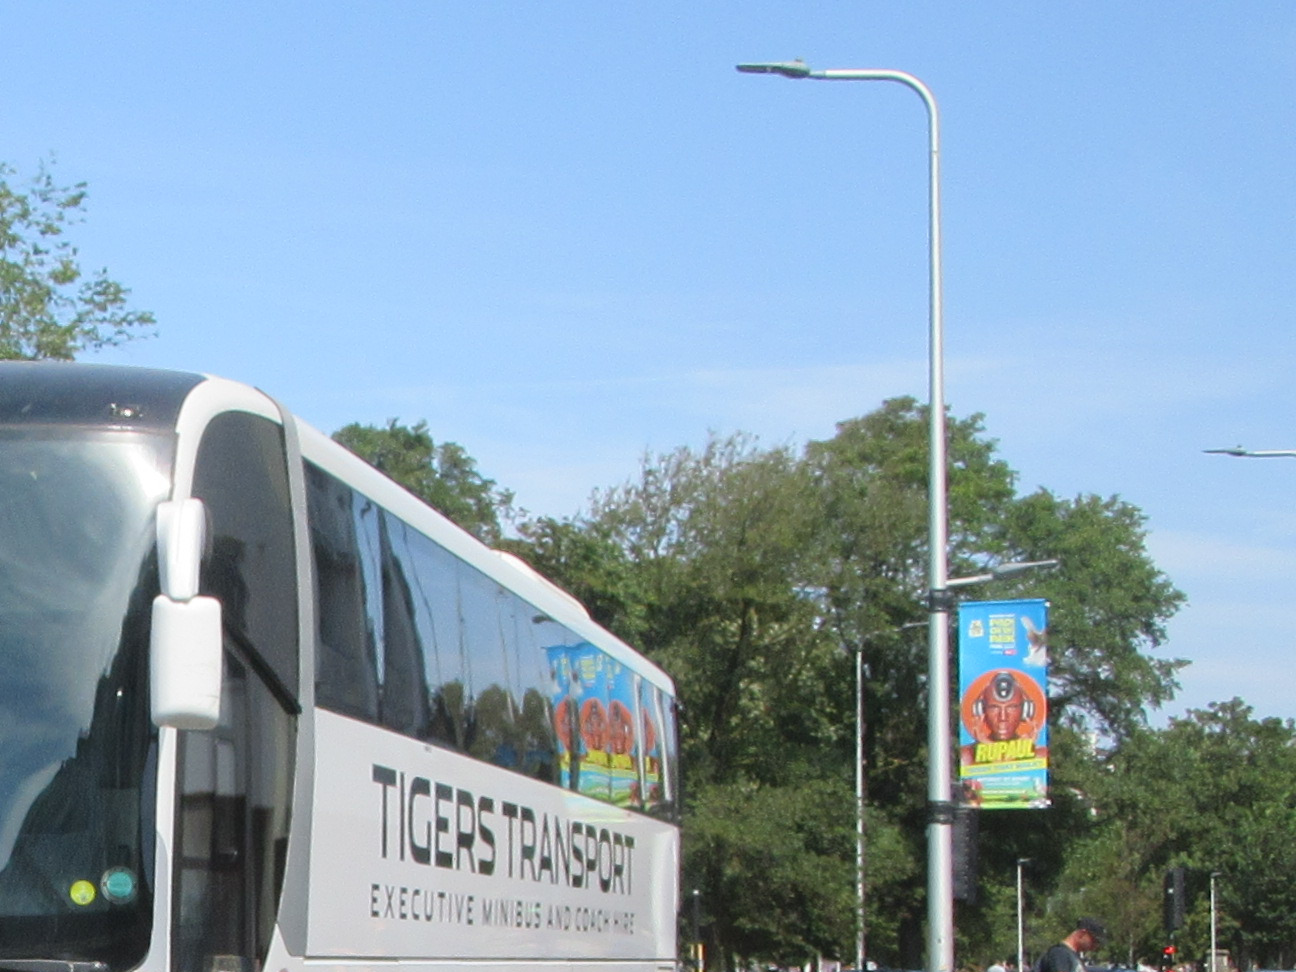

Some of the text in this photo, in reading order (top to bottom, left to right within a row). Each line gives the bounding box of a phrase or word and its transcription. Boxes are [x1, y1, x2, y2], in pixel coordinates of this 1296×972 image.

[975, 738, 1036, 763] RUPAUL
[371, 763, 636, 896] TIGERS TRANSPORT
[370, 883, 474, 926] EXECUTIVE
[481, 898, 541, 928] MINIBUS
[547, 904, 571, 931] AND
[575, 906, 610, 933] COACH
